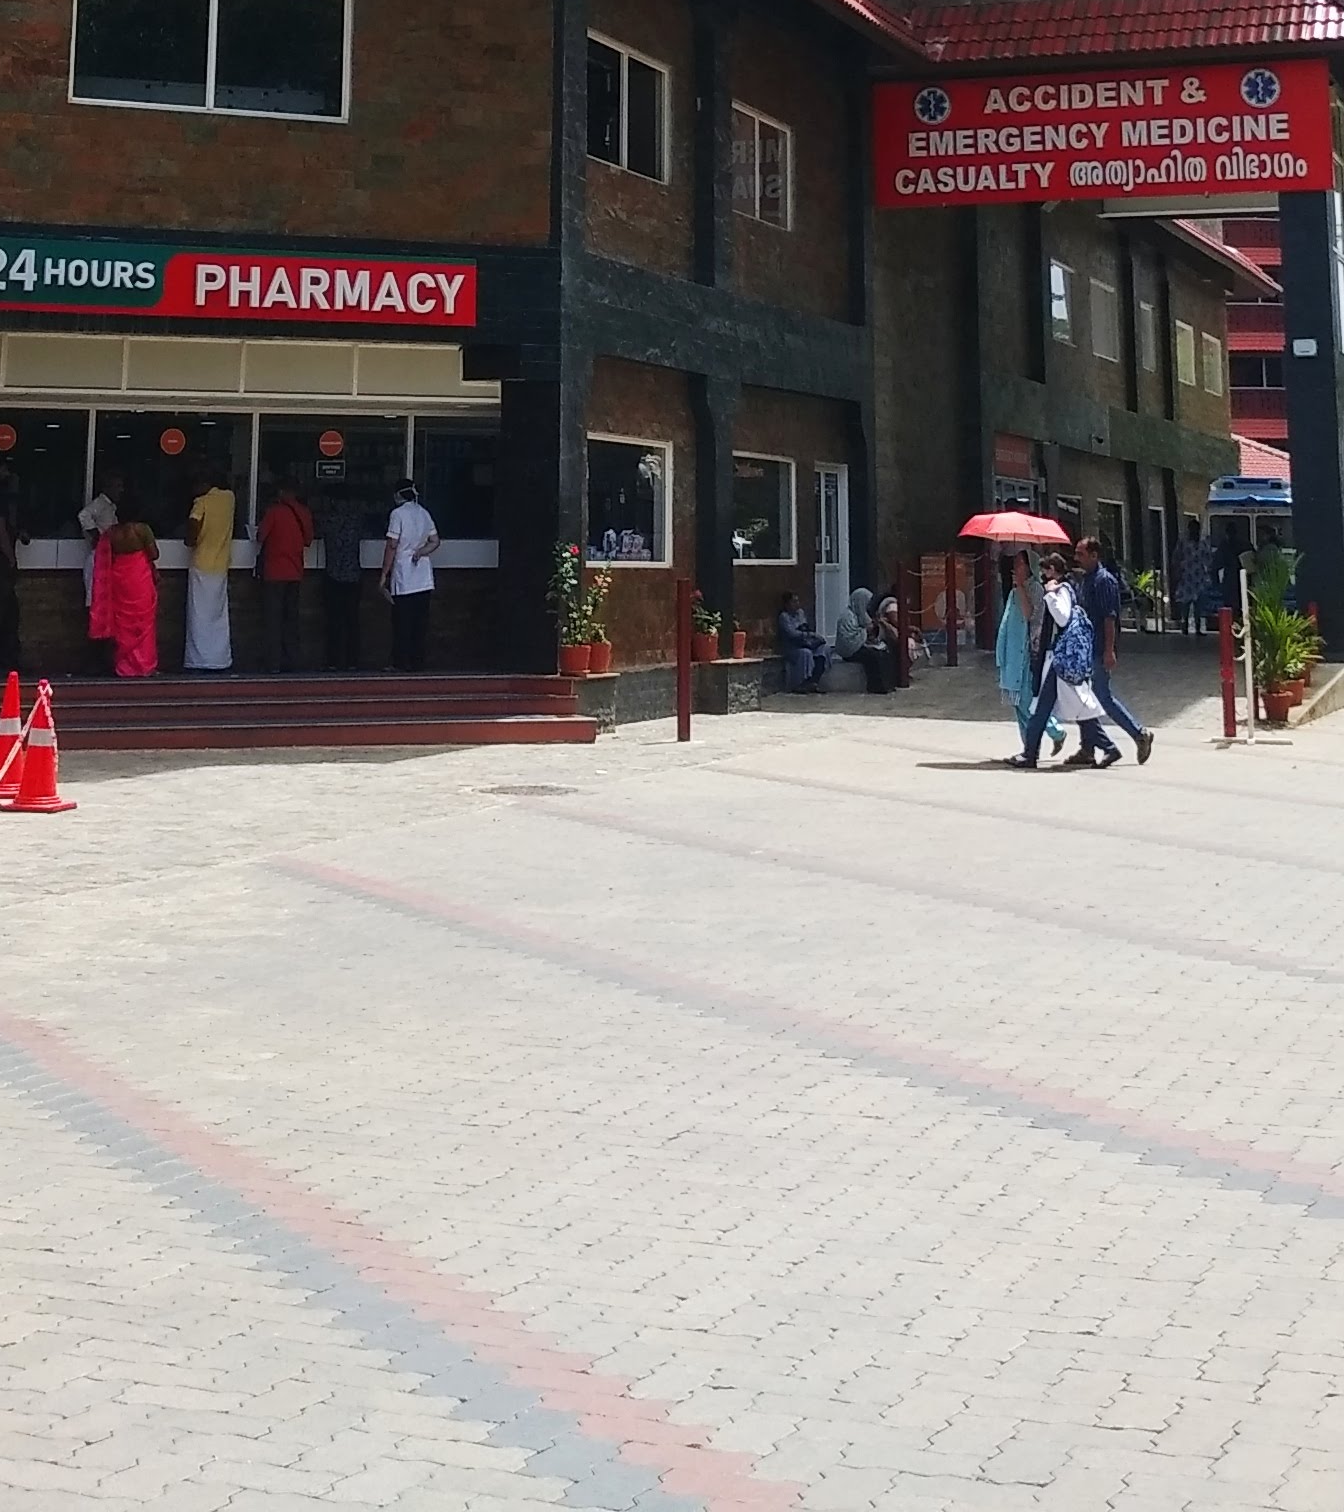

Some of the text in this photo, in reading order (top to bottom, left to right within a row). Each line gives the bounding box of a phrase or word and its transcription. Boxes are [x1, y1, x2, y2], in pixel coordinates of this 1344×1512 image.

[982, 75, 1208, 114] ACCIDENT &
[907, 113, 1290, 157] EMERGENCY MEDICINE
[894, 161, 1056, 195] CASUALTY
[1069, 146, 1308, 192] അത്യാഹിത വിഭാഗം
[42, 257, 156, 289] HOURS
[195, 263, 466, 315] PHARMACY
